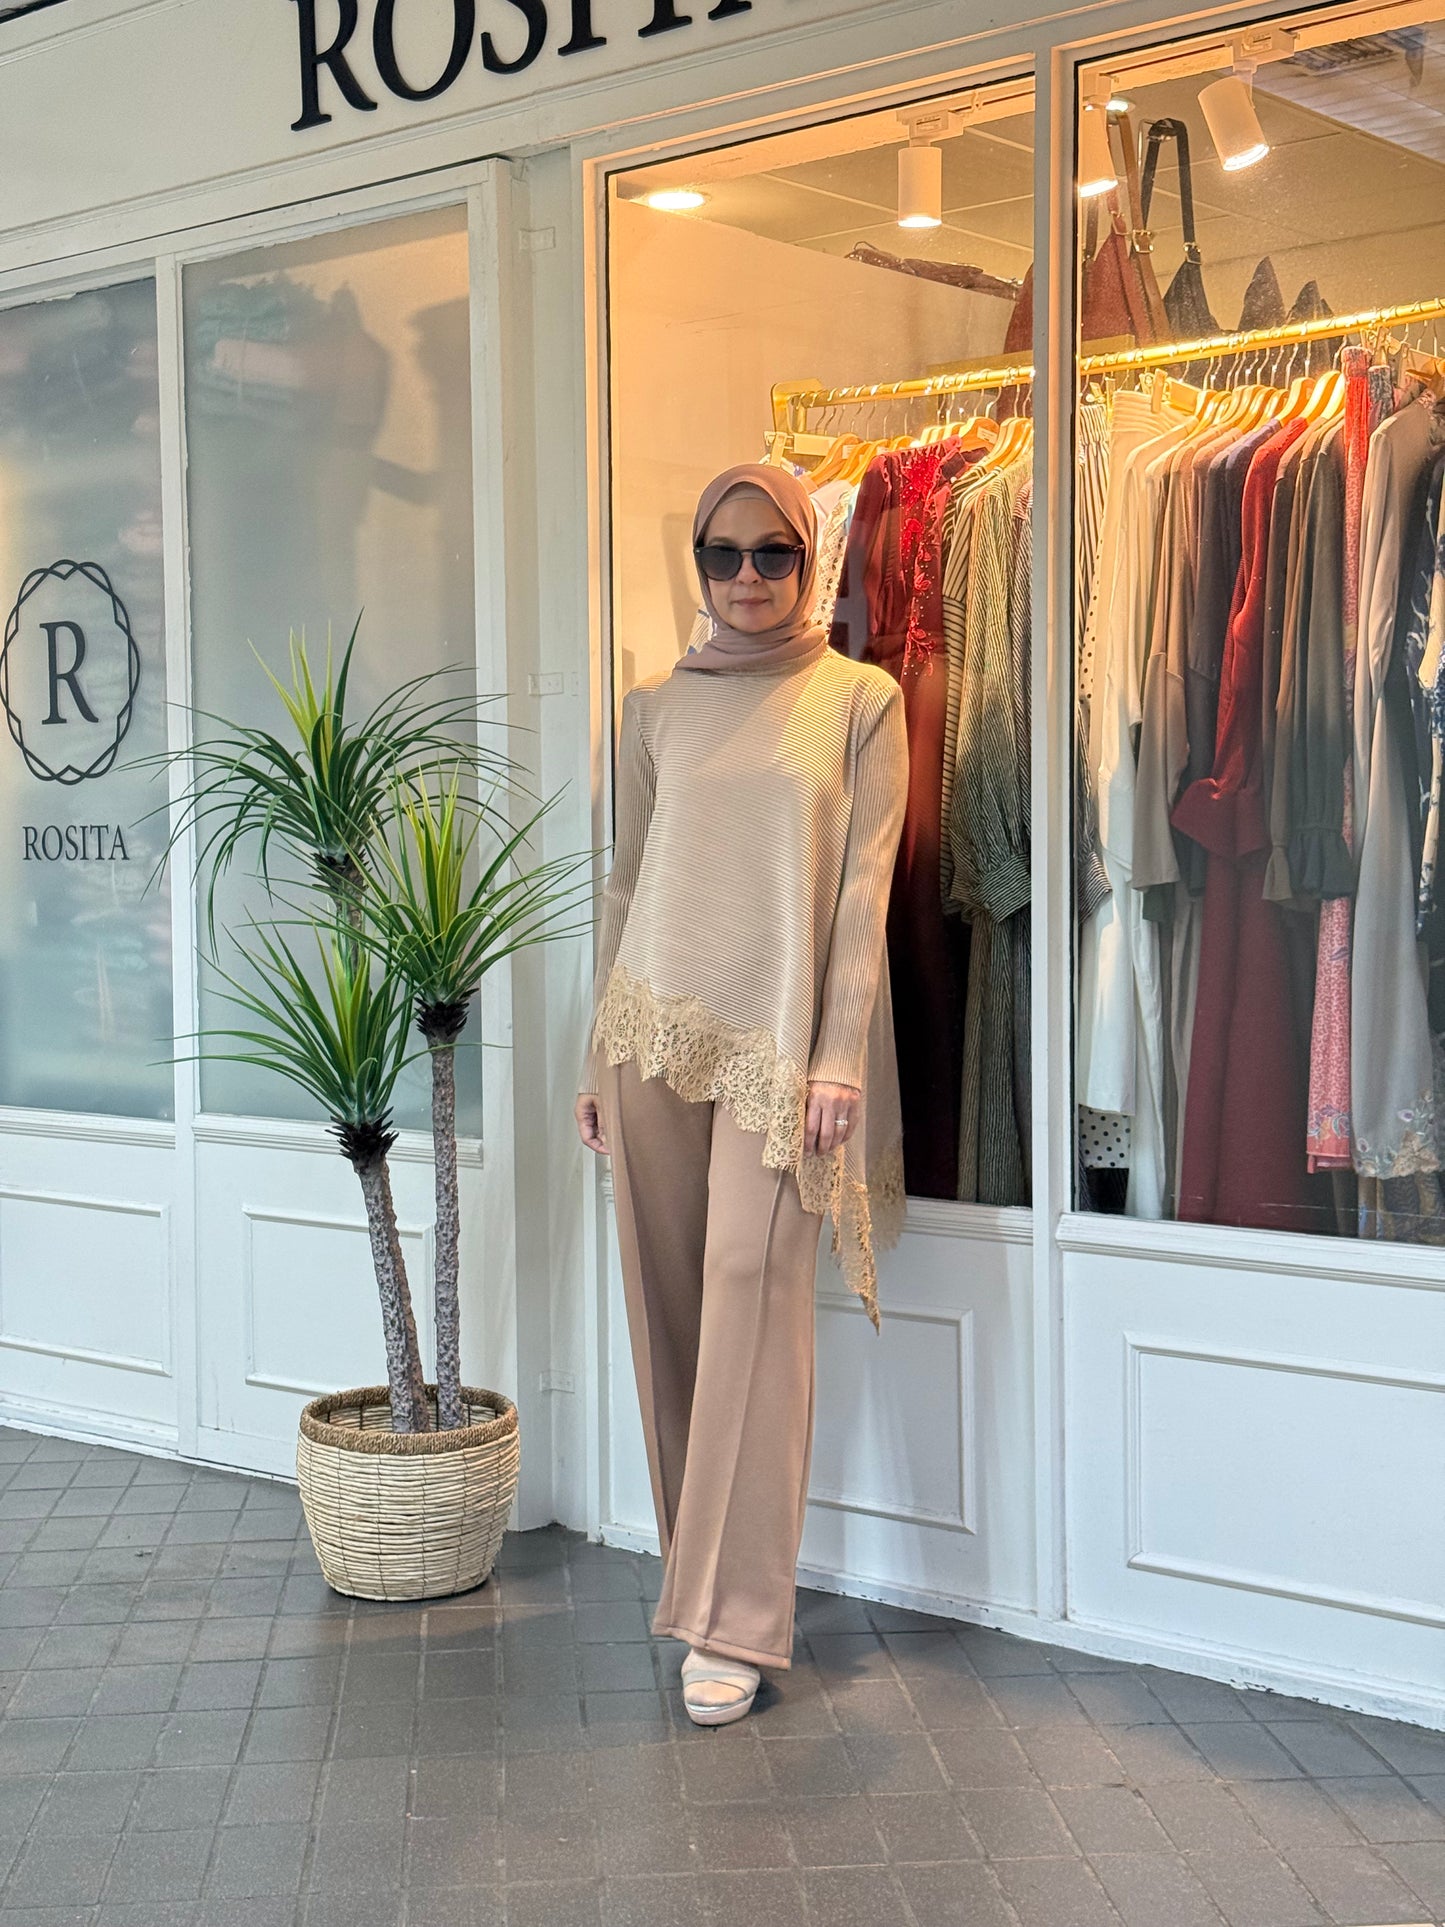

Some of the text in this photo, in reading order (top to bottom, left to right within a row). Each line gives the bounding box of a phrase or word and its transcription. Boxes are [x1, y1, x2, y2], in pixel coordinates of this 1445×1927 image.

[290, 0, 753, 132] ROS
[39, 620, 99, 725] R
[22, 824, 130, 861] ROSITA
